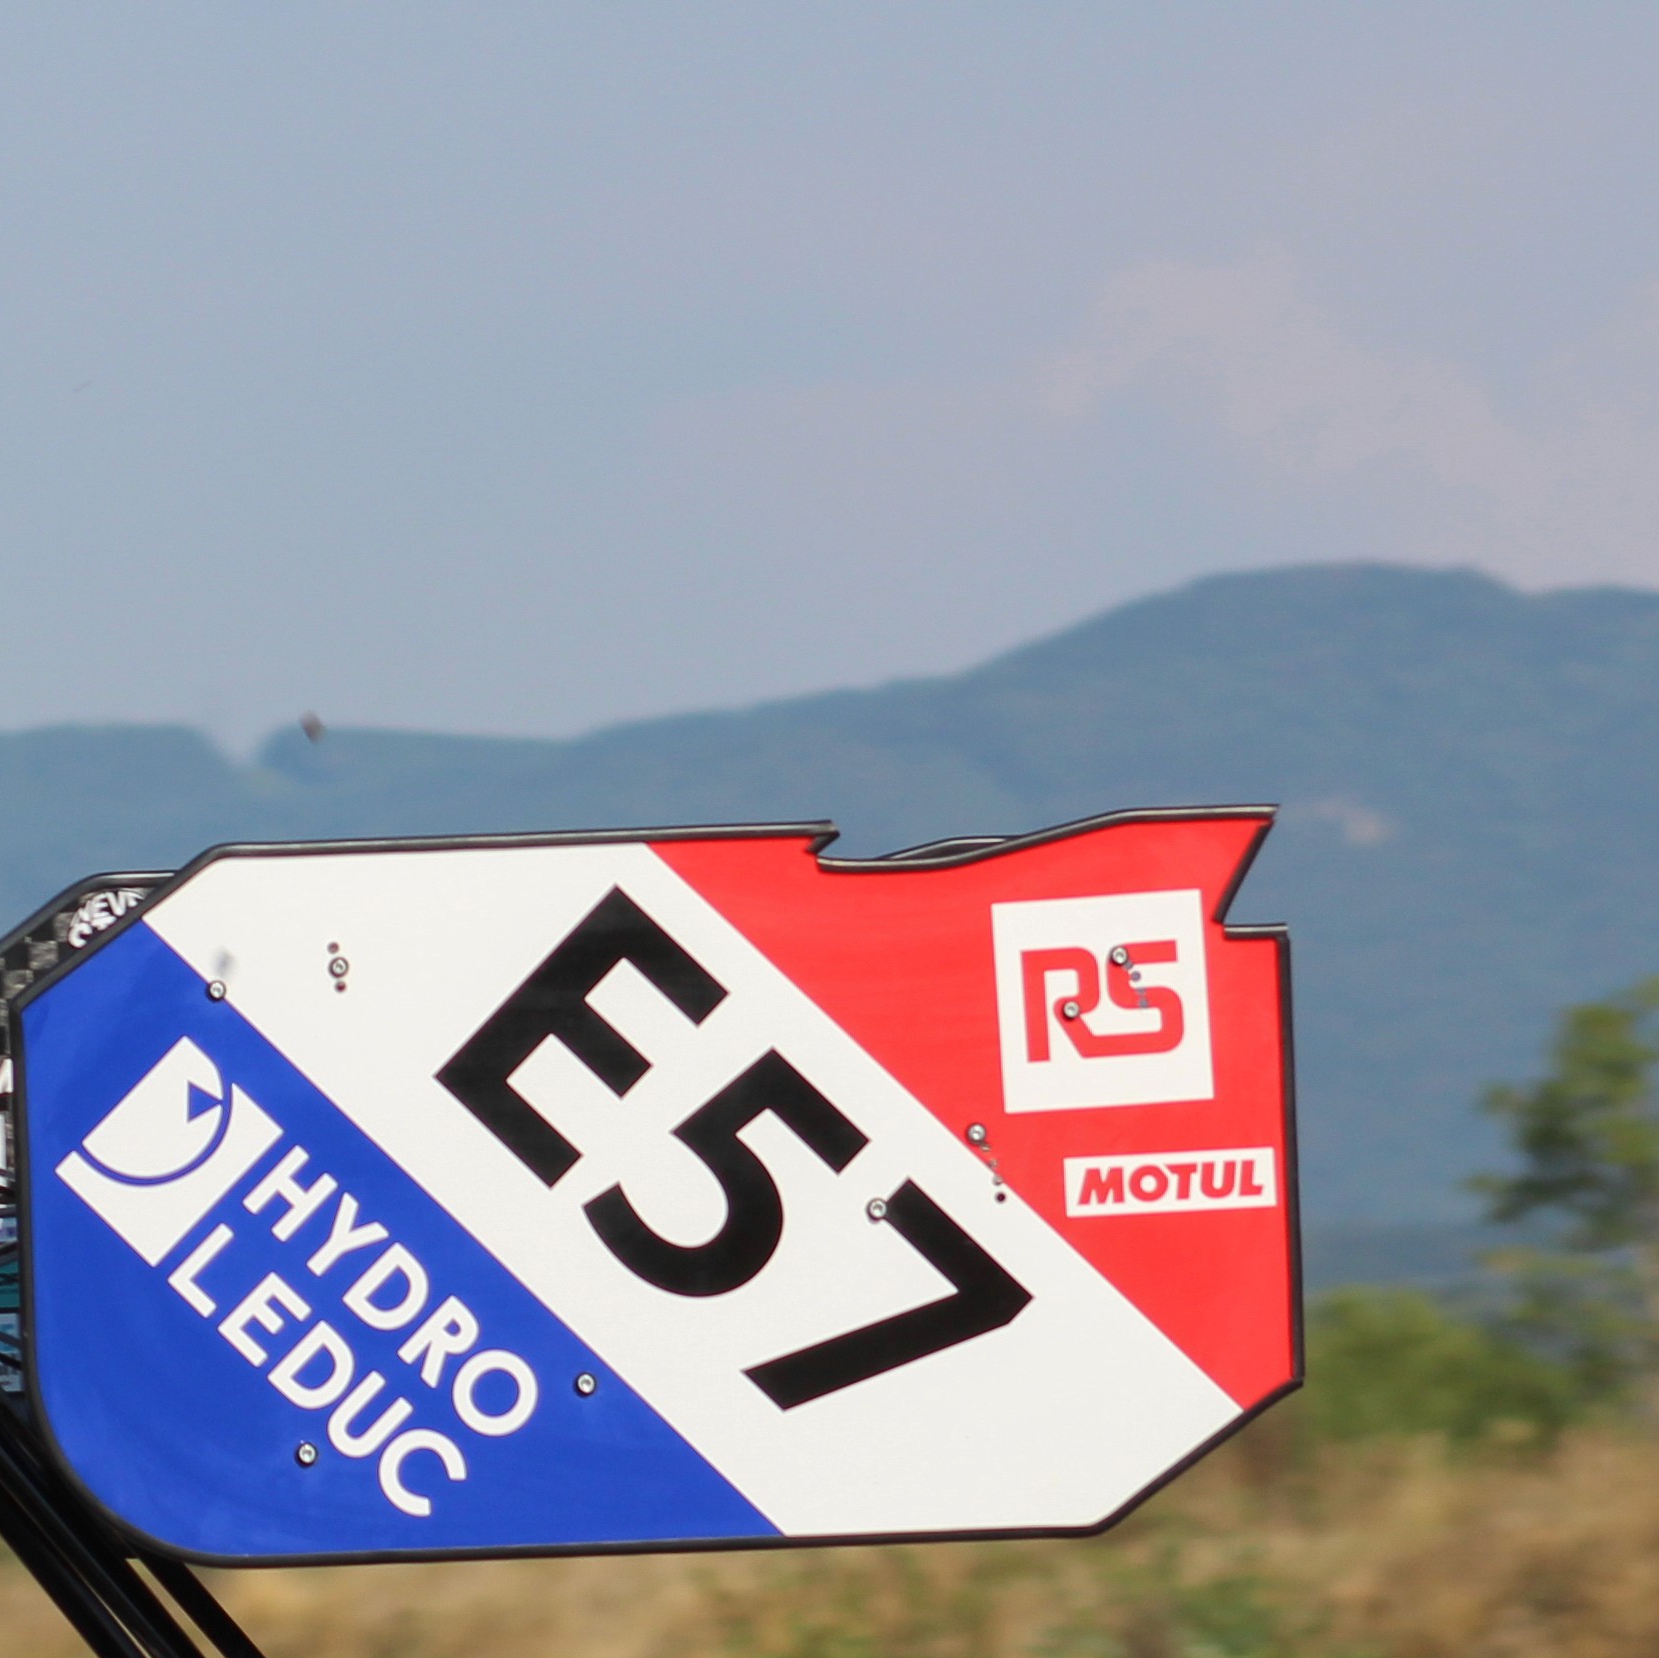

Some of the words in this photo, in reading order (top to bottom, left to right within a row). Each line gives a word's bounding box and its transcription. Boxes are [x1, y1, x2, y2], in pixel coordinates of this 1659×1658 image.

[1020, 939, 1185, 1064] RS
[243, 1145, 539, 1437] HYDRO
[433, 884, 1034, 1412] E57
[1077, 1159, 1264, 1206] MOTUL
[167, 1223, 467, 1517] LEDUC
